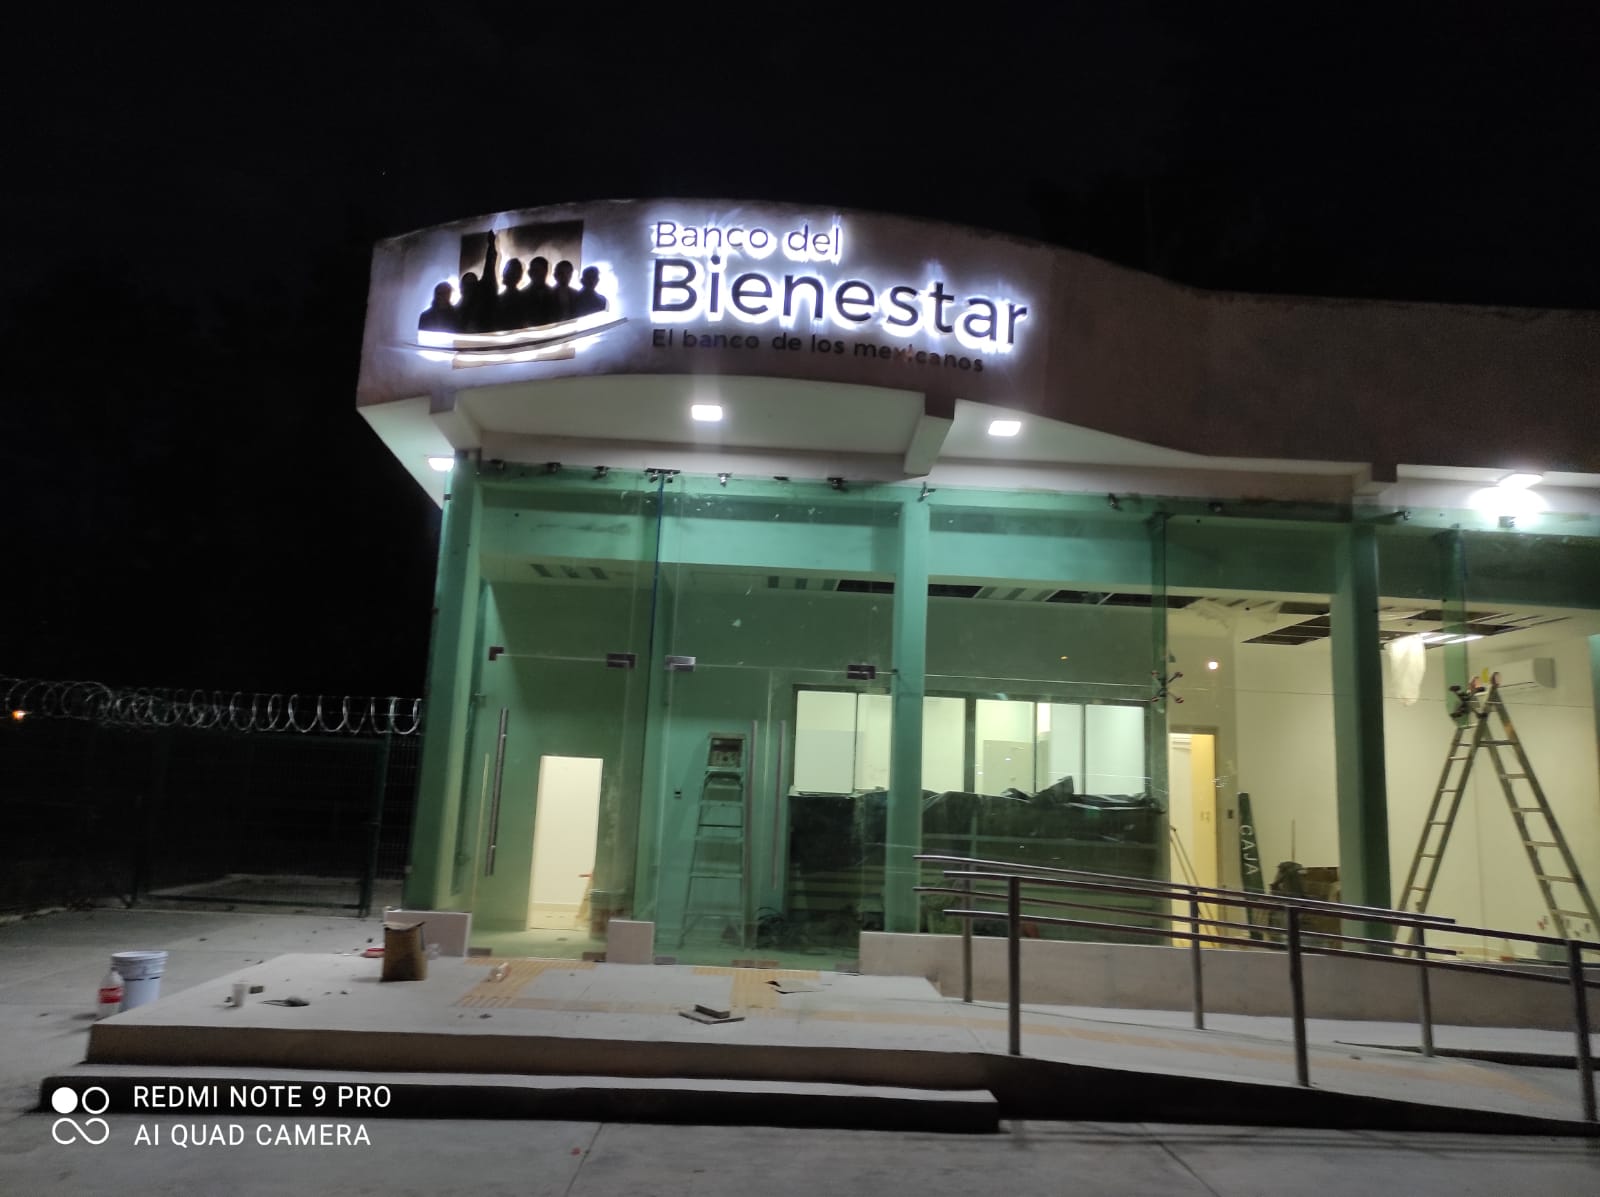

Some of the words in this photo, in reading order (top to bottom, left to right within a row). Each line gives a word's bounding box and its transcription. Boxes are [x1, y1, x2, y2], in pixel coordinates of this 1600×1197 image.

[655, 220, 769, 249] Banco
[786, 223, 839, 255] del
[651, 254, 1028, 345] Bienestar
[651, 328, 673, 348] El
[682, 328, 759, 349] banco
[771, 330, 801, 351] de
[811, 333, 845, 355] los
[853, 342, 984, 373] mexicanos
[1240, 824, 1259, 875] CAJA
